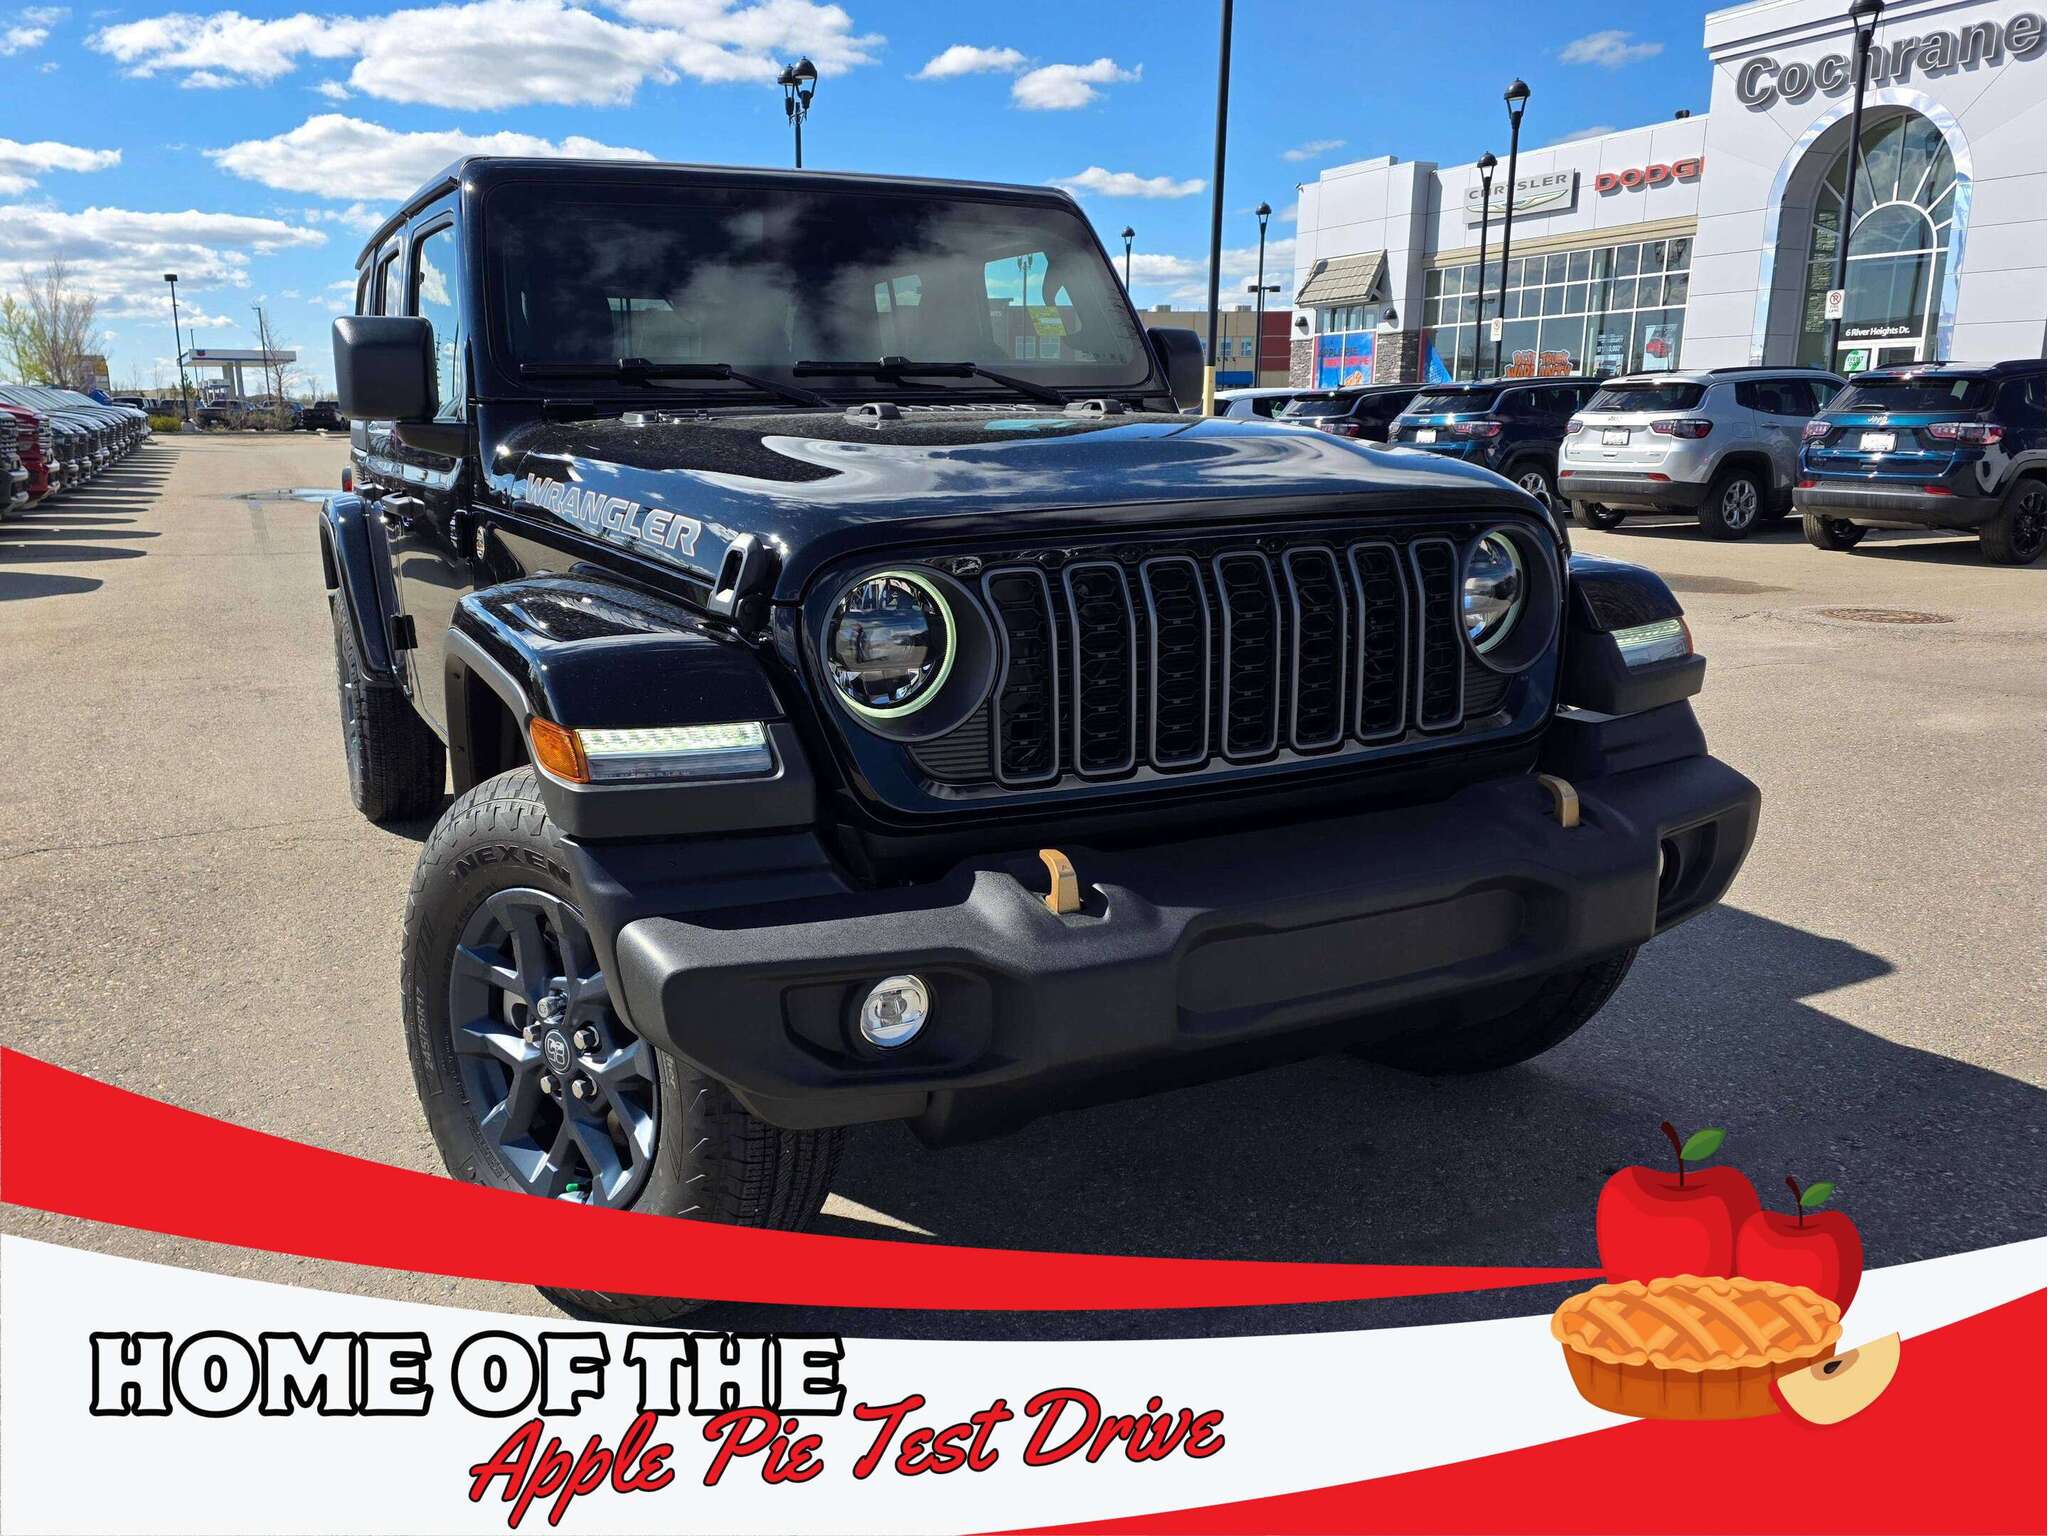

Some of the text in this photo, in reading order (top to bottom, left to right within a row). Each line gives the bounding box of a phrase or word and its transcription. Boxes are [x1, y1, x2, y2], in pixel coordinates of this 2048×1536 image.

[1736, 11, 2043, 107] Cochrane
[1595, 156, 1705, 192] DODG
[1845, 329, 1851, 337] 6
[1851, 327, 1870, 336] River
[1870, 326, 1898, 337] Heights
[525, 472, 702, 557] WRANGLER
[455, 844, 572, 888] NEXEN
